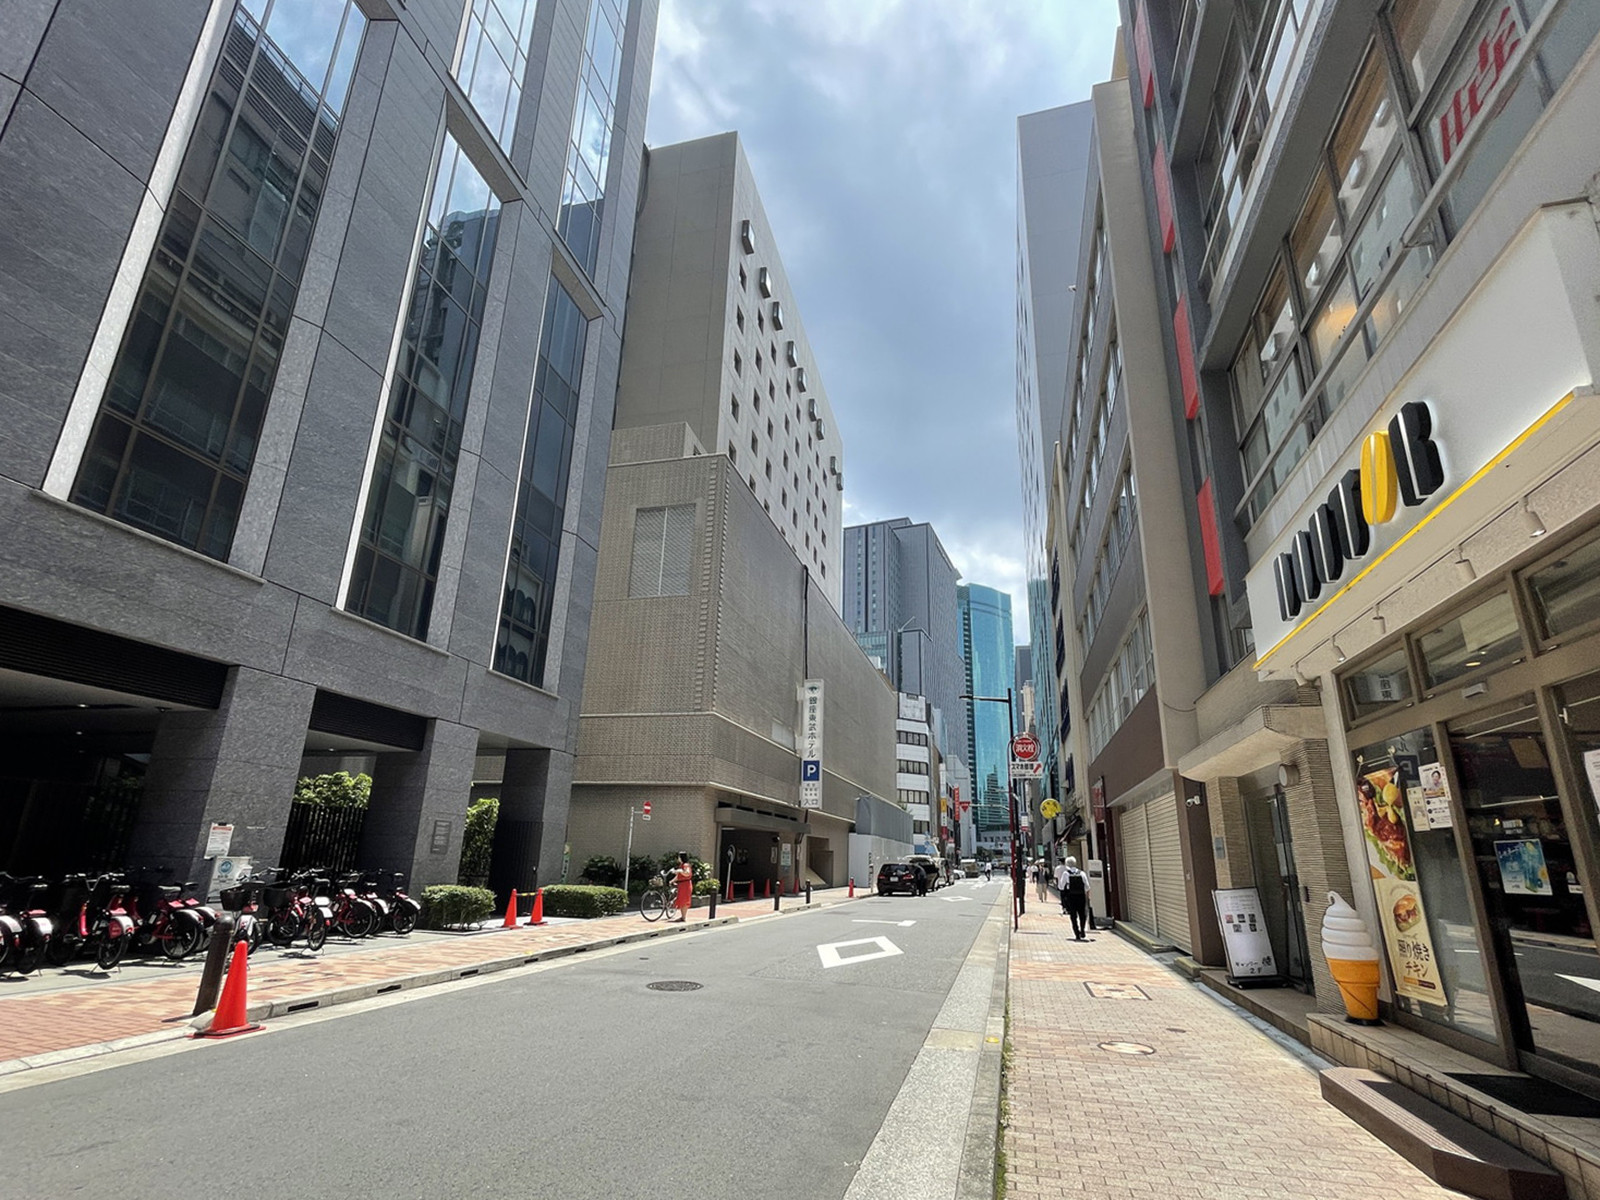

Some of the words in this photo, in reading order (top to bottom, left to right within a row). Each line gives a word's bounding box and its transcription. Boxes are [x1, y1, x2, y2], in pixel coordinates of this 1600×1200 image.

[807, 696, 818, 759] 銀座東武ホテル
[1015, 743, 1035, 753] 消火栓
[807, 765, 817, 777] P
[803, 798, 818, 806] 入口
[1405, 961, 1429, 978] チキン
